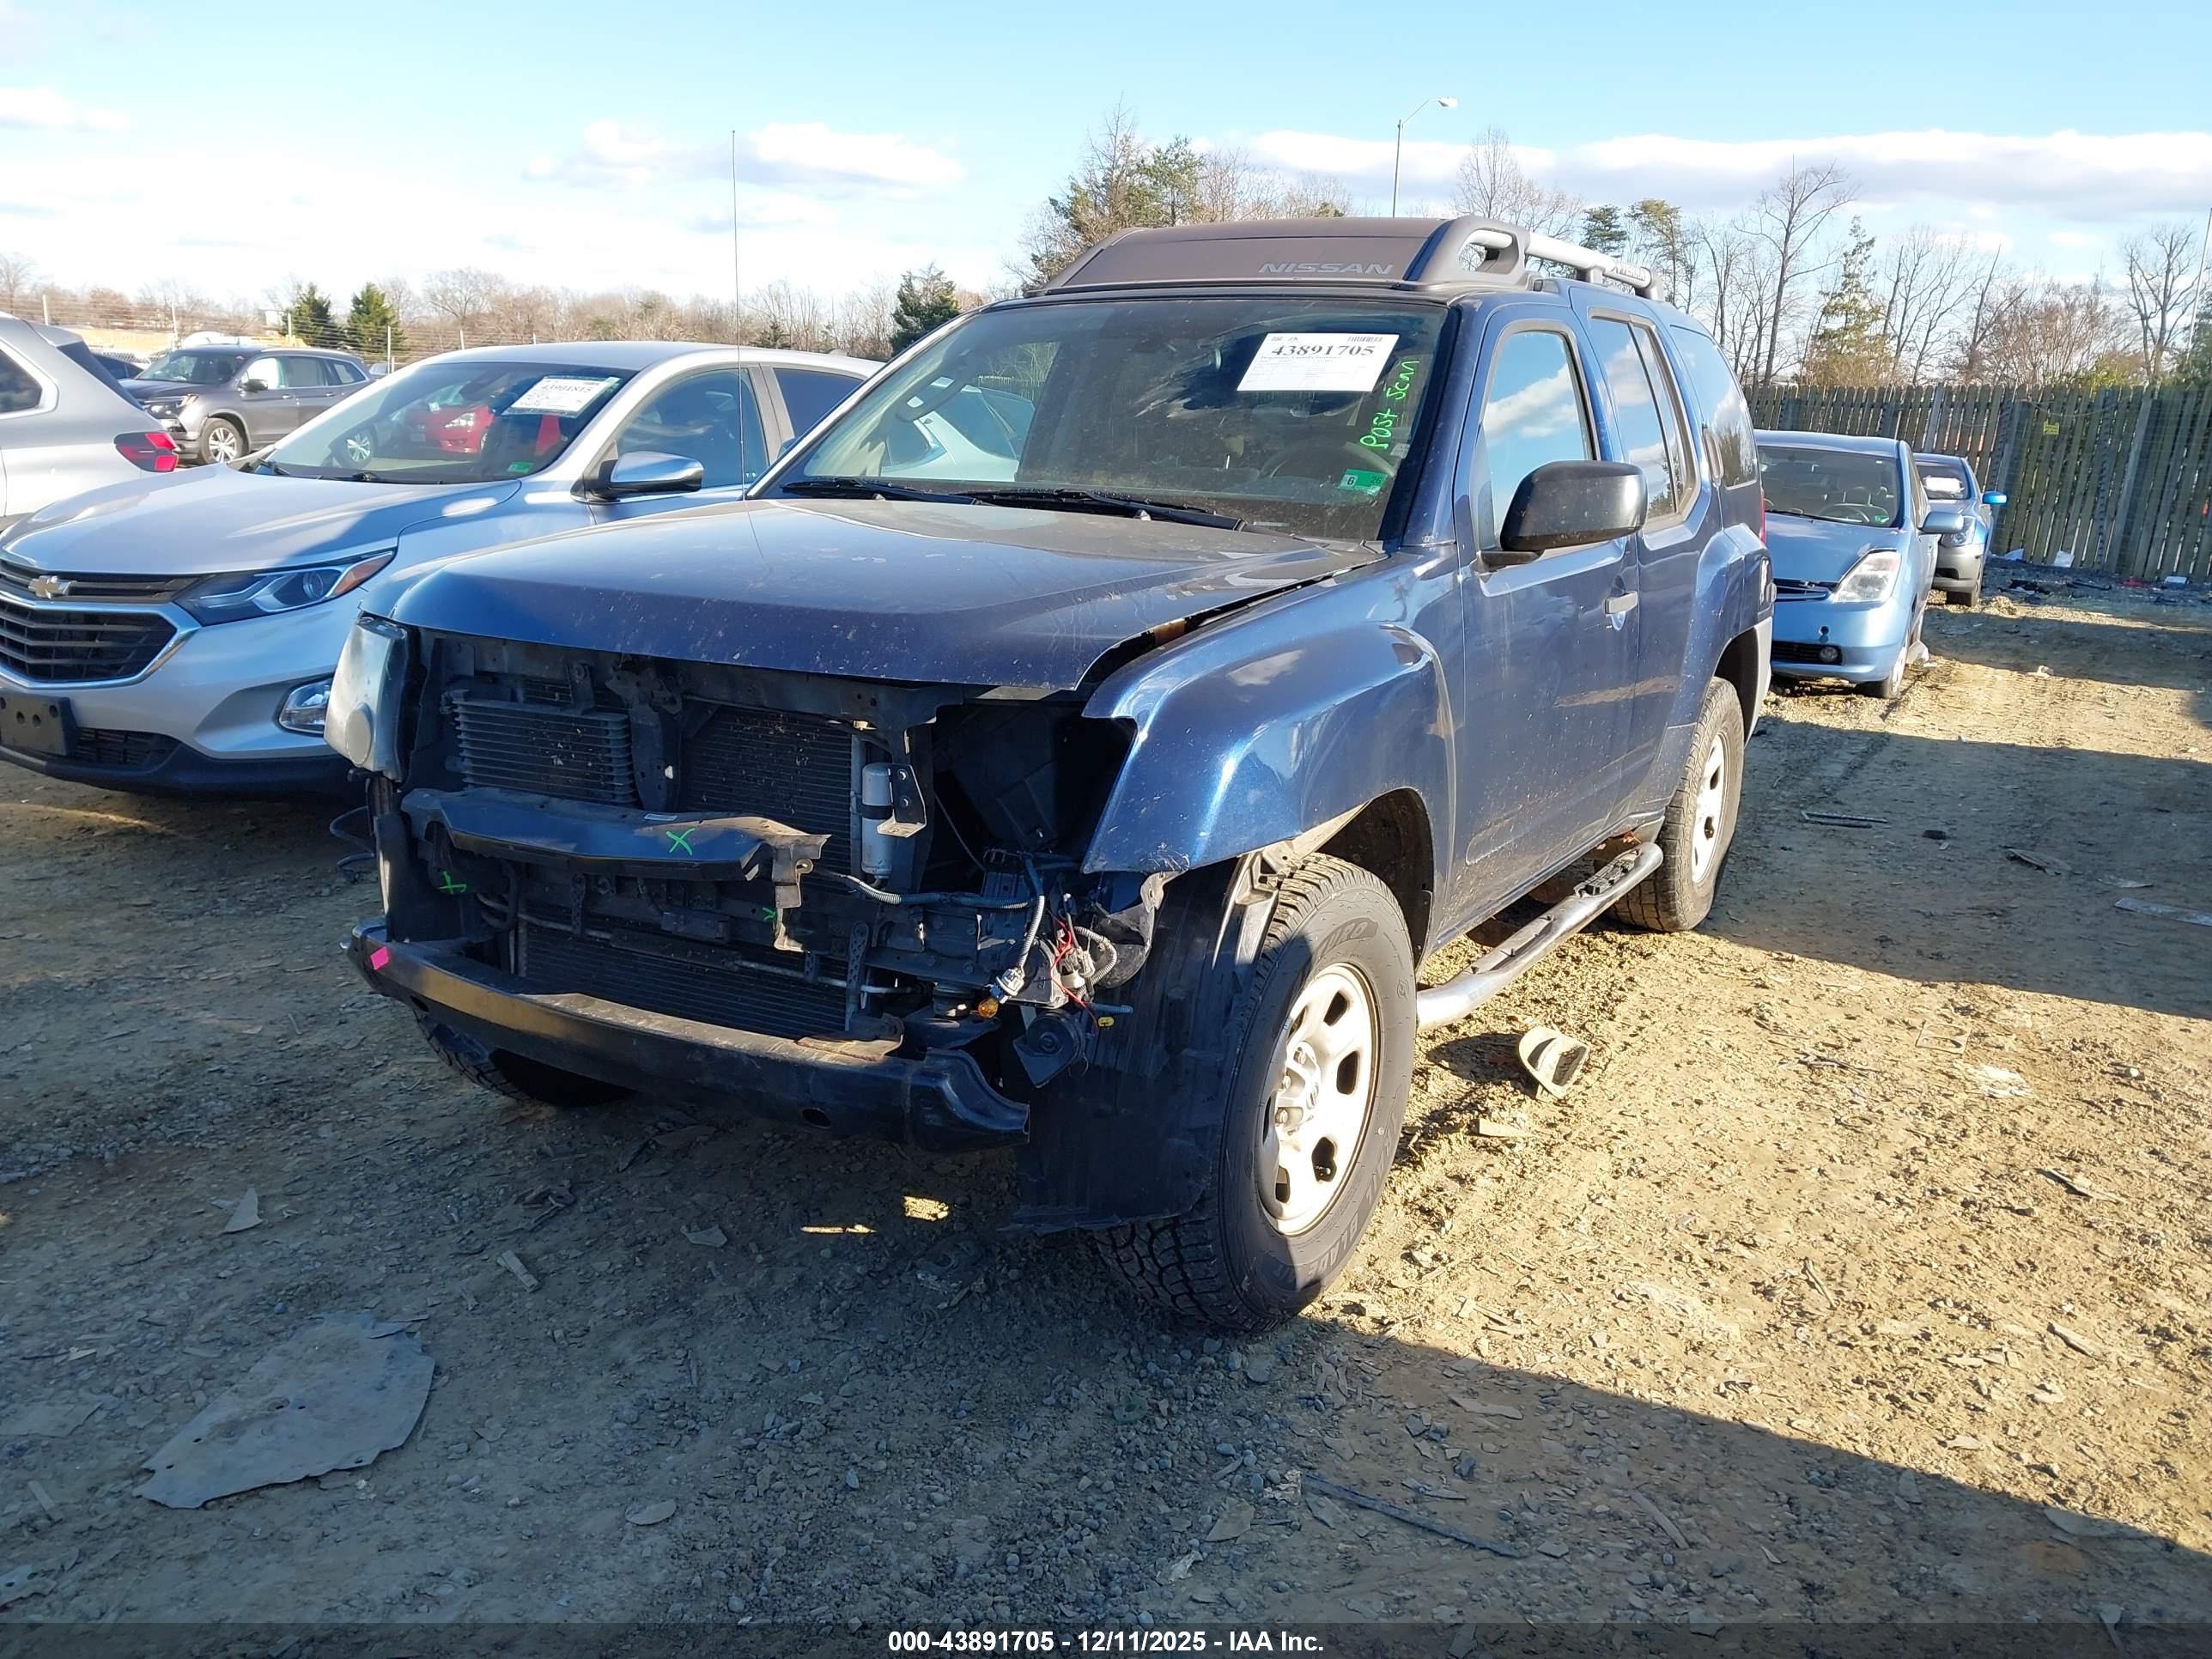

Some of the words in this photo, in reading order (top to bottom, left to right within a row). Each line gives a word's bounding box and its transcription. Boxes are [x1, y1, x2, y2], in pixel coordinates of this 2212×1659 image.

[1258, 263, 1394, 275] NISSAN
[1272, 344, 1376, 356] 43891705
[1347, 477, 1355, 486] 6
